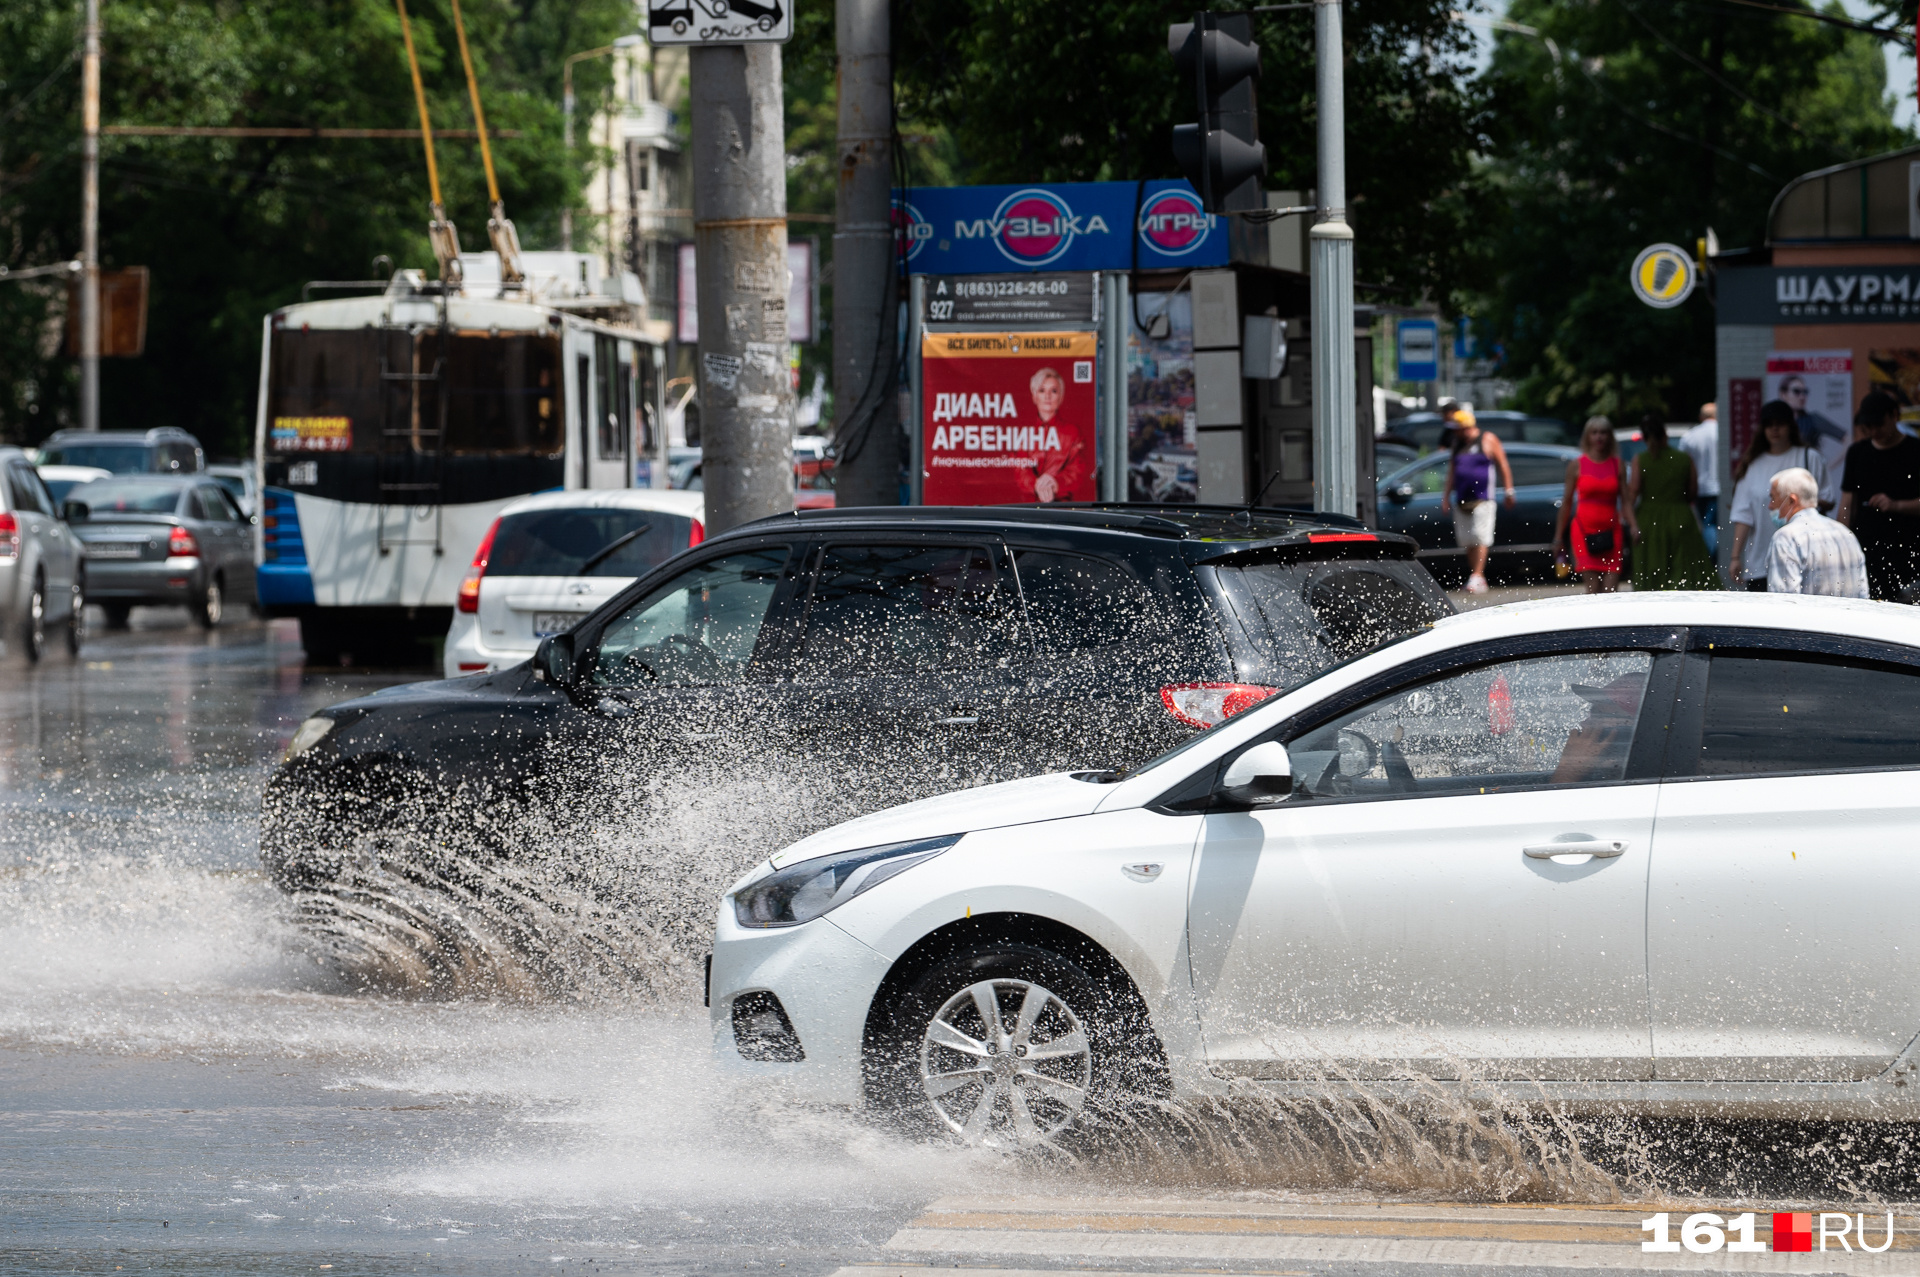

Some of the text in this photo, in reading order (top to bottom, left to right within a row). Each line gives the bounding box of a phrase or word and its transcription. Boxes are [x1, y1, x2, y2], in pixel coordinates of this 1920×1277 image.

[954, 215, 1110, 239] МУЗЫКА
[1138, 212, 1217, 231] ИГРЫ
[955, 281, 1069, 298] 8(863)226-26-00
[930, 300, 954, 320] 927
[956, 313, 975, 321] ООО
[947, 337, 1072, 350] ВСЕ БИЛЕТЫ KASSIR.RU
[932, 393, 1017, 422] ДИАНА
[931, 424, 1062, 452] АРБЕНИНА
[931, 453, 1039, 469] #ночныеснайперы
